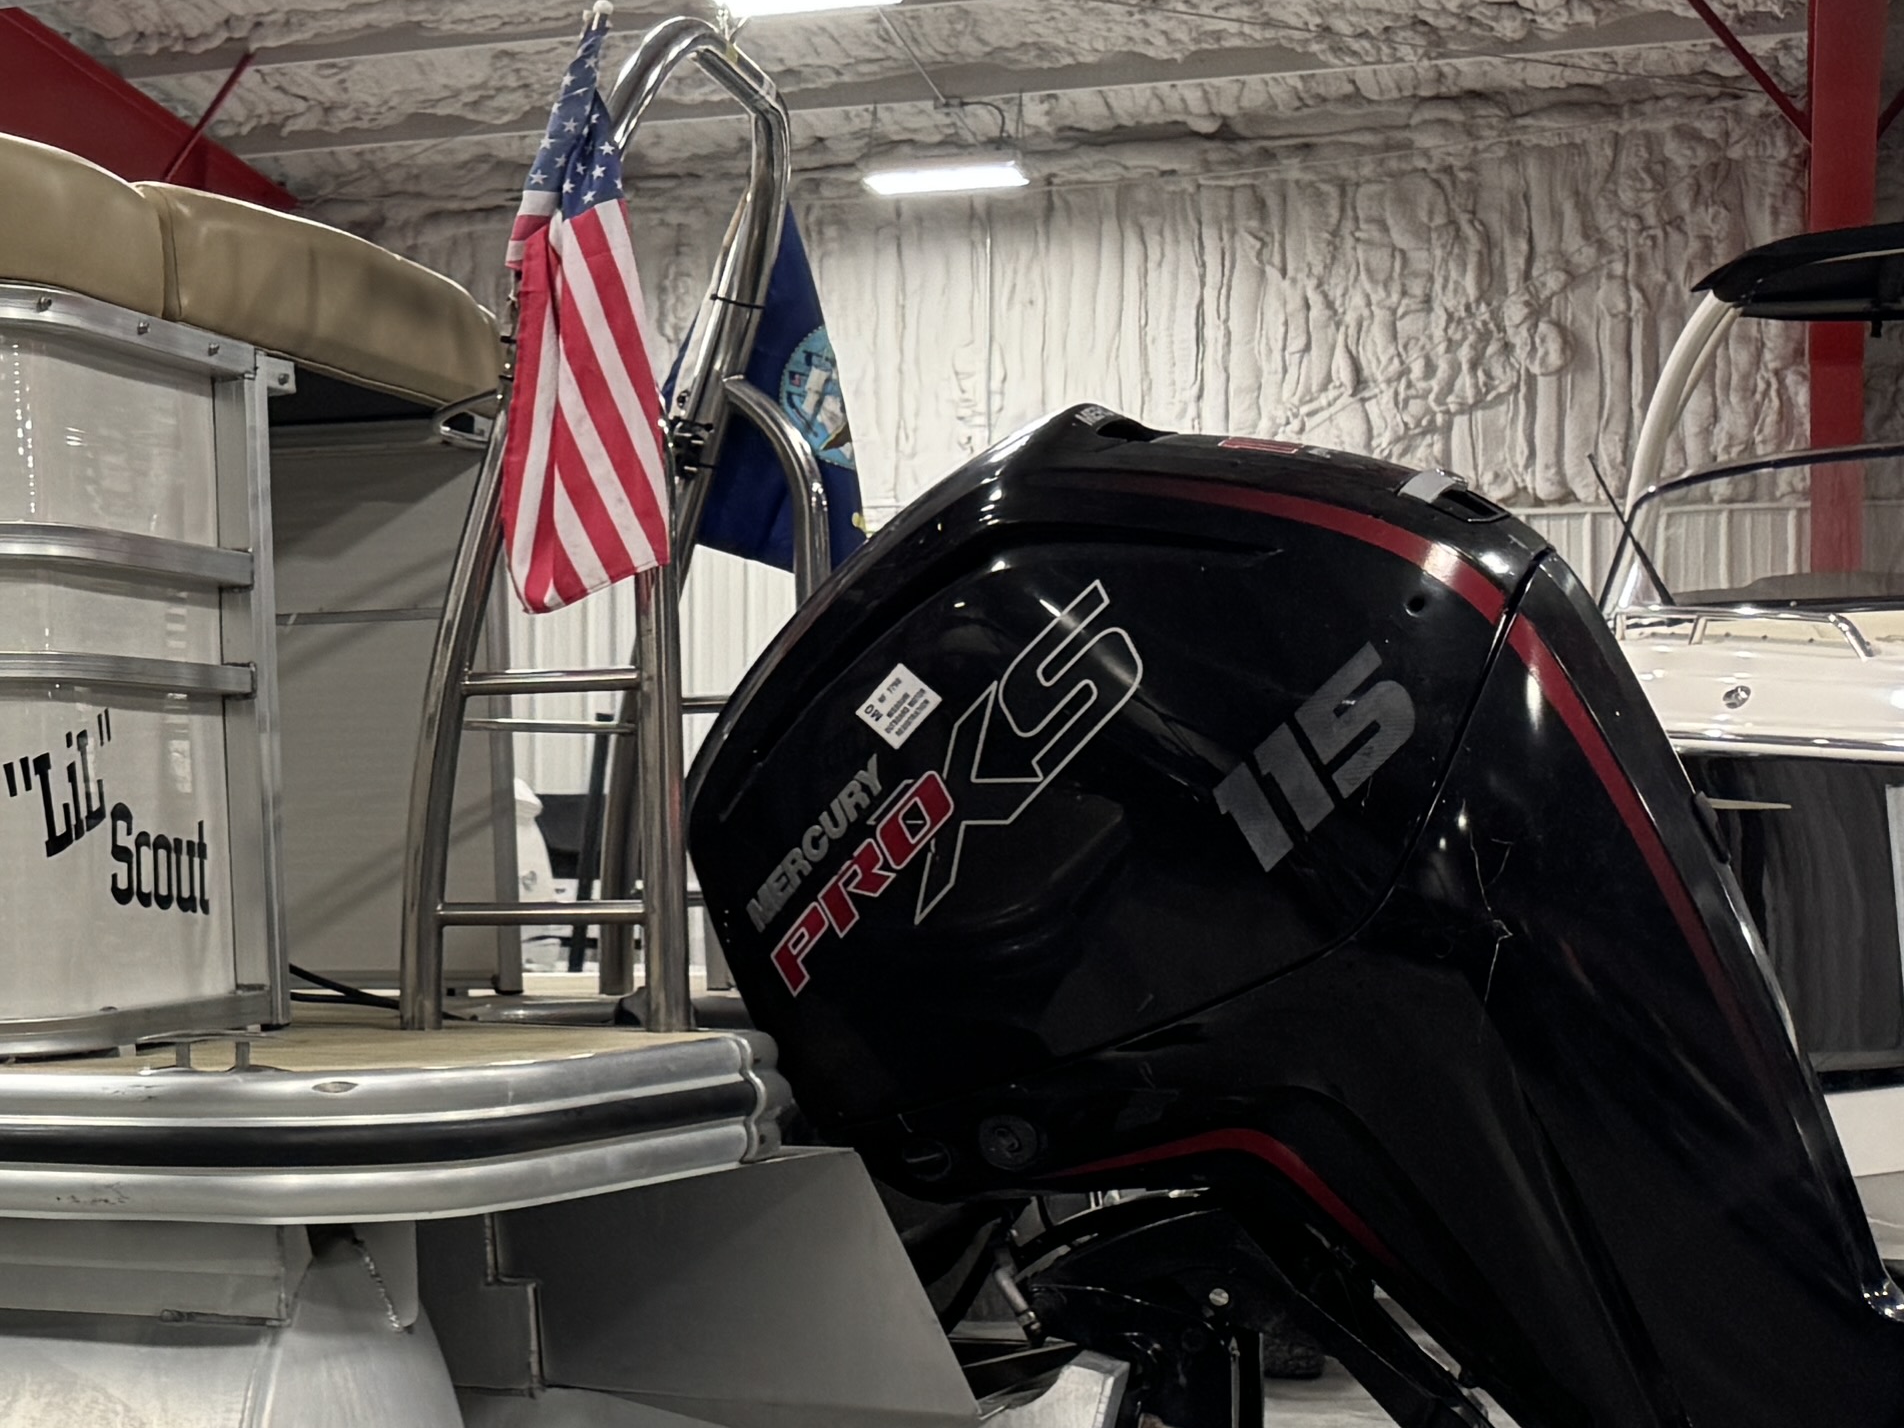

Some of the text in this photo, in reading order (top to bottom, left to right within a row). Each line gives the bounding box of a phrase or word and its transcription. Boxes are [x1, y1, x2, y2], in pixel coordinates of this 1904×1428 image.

[864, 703, 884, 722] MO
[1213, 640, 1417, 874] 115
[110, 802, 211, 915] Scout
[745, 754, 886, 934] MERCURY
[769, 770, 955, 998] PRO
